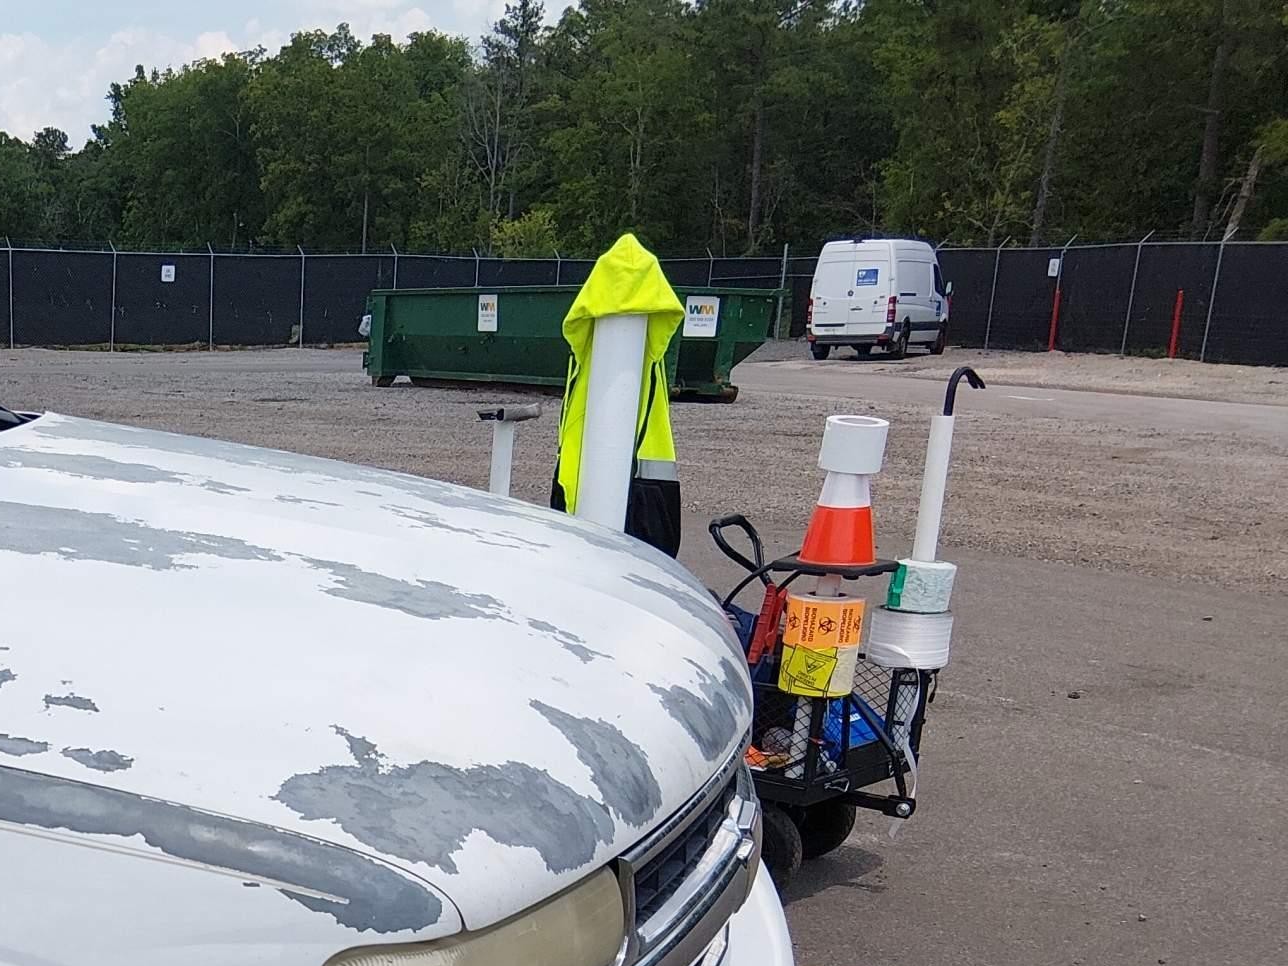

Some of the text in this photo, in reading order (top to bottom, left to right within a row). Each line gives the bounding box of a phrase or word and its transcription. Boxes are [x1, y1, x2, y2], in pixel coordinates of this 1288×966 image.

[480, 302, 495, 312] WM
[689, 304, 715, 315] WM
[801, 607, 811, 642] BIOPELIGRO
[808, 608, 818, 642] BIOHAZARD
